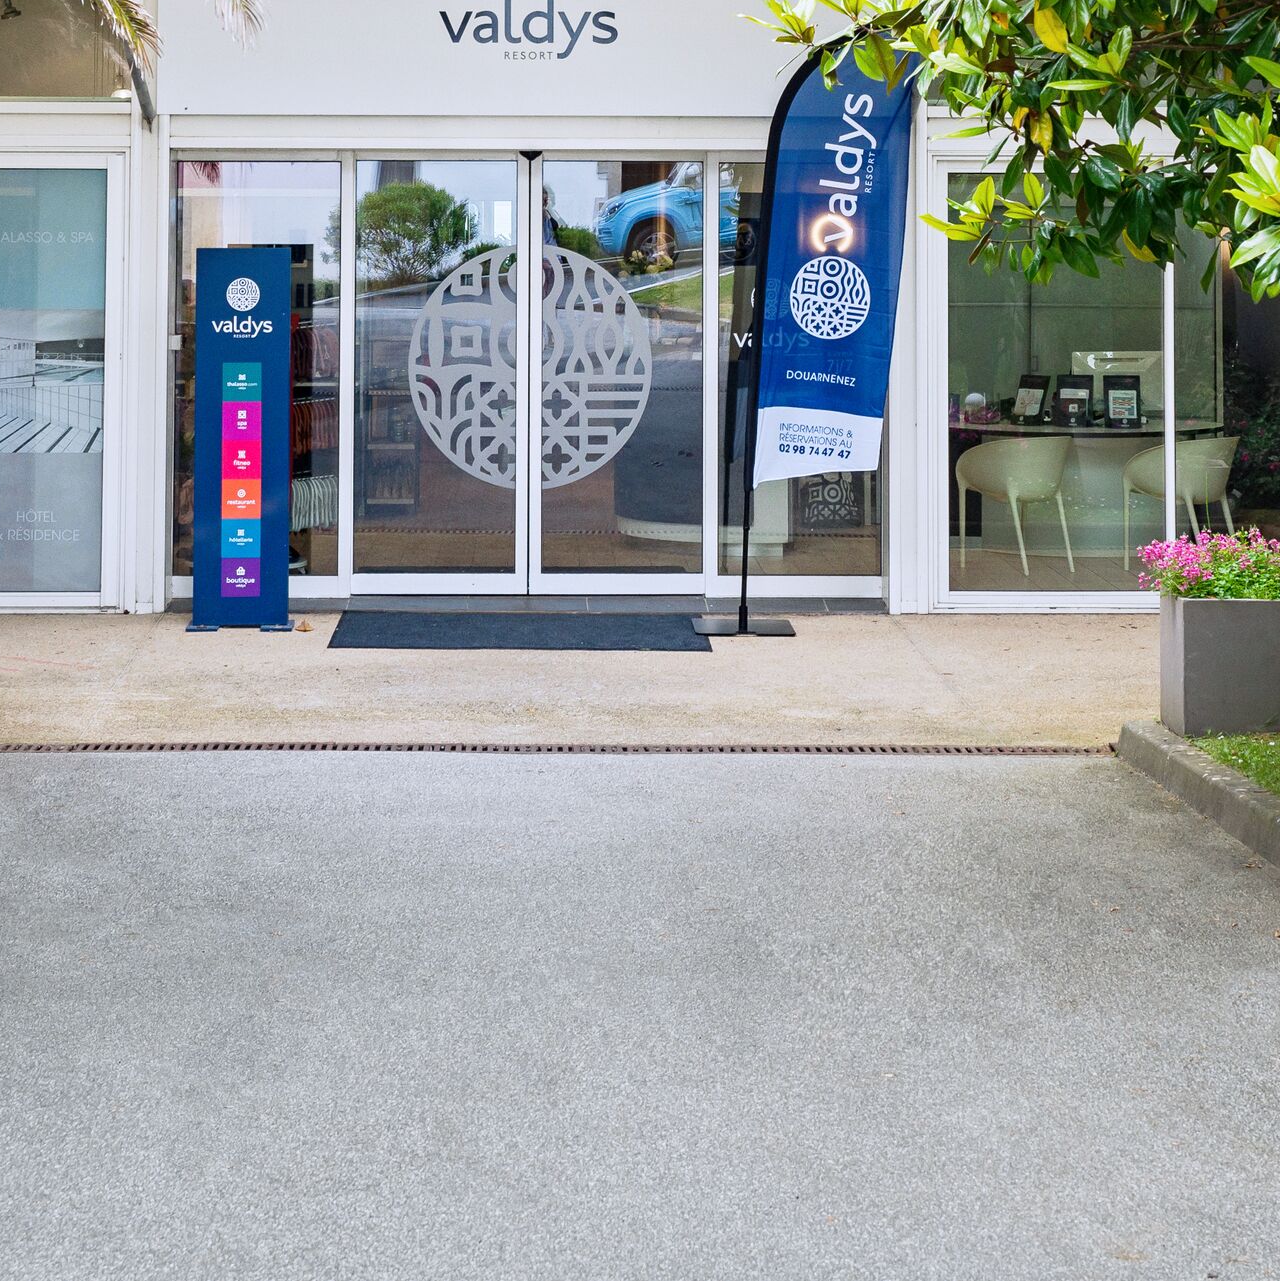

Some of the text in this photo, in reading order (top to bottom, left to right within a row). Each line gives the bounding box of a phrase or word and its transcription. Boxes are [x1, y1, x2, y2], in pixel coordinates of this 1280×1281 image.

[504, 51, 553, 60] RESORT
[819, 93, 877, 243] valdys
[865, 152, 877, 194] RESORT
[56, 231, 66, 243] &
[71, 231, 94, 243] SPA
[211, 315, 273, 338] valdys
[786, 369, 856, 387] DOUARNENEZ
[779, 422, 853, 438] INFORMATIONS &
[779, 432, 853, 448] RÉSERVATIONS AU
[779, 443, 851, 459] 02 98 74 47 47
[16, 508, 57, 523] HÔTEL
[7, 526, 80, 541] RÉSIDENCE
[226, 577, 256, 585] boutique
